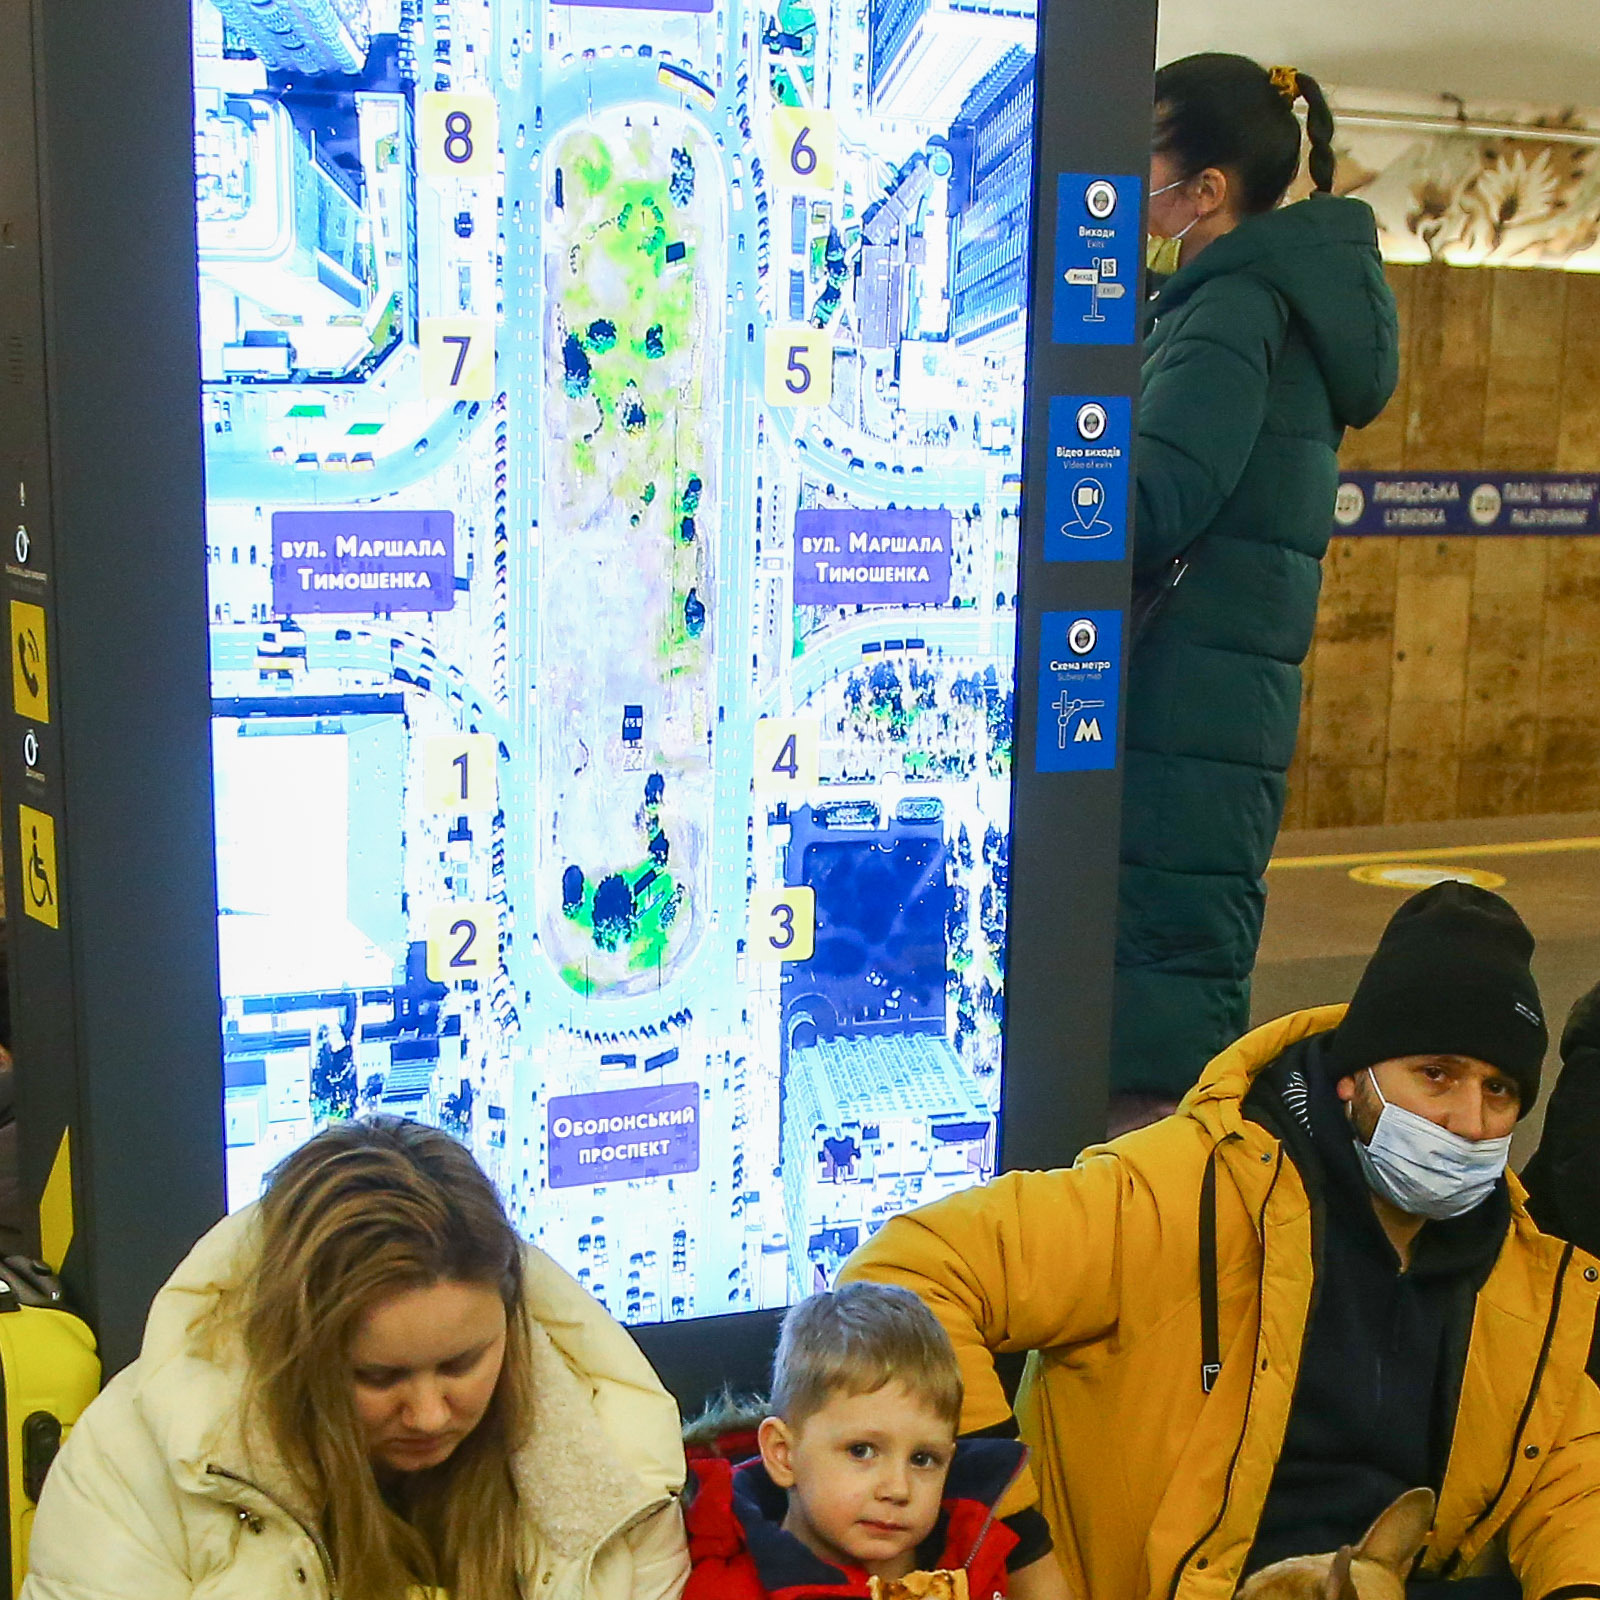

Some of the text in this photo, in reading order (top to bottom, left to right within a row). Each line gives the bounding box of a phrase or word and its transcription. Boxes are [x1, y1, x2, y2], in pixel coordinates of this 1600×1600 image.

[444, 111, 474, 164] 8
[790, 126, 819, 176] 6
[1079, 226, 1116, 239] Виходи
[442, 336, 472, 386] 7
[785, 346, 811, 394] 5
[1056, 446, 1121, 459] Відео виходів
[1050, 660, 1111, 673] Схема метро
[451, 753, 469, 800] 1
[771, 734, 800, 780] 4
[449, 919, 478, 968] 2
[768, 904, 795, 949] 3
